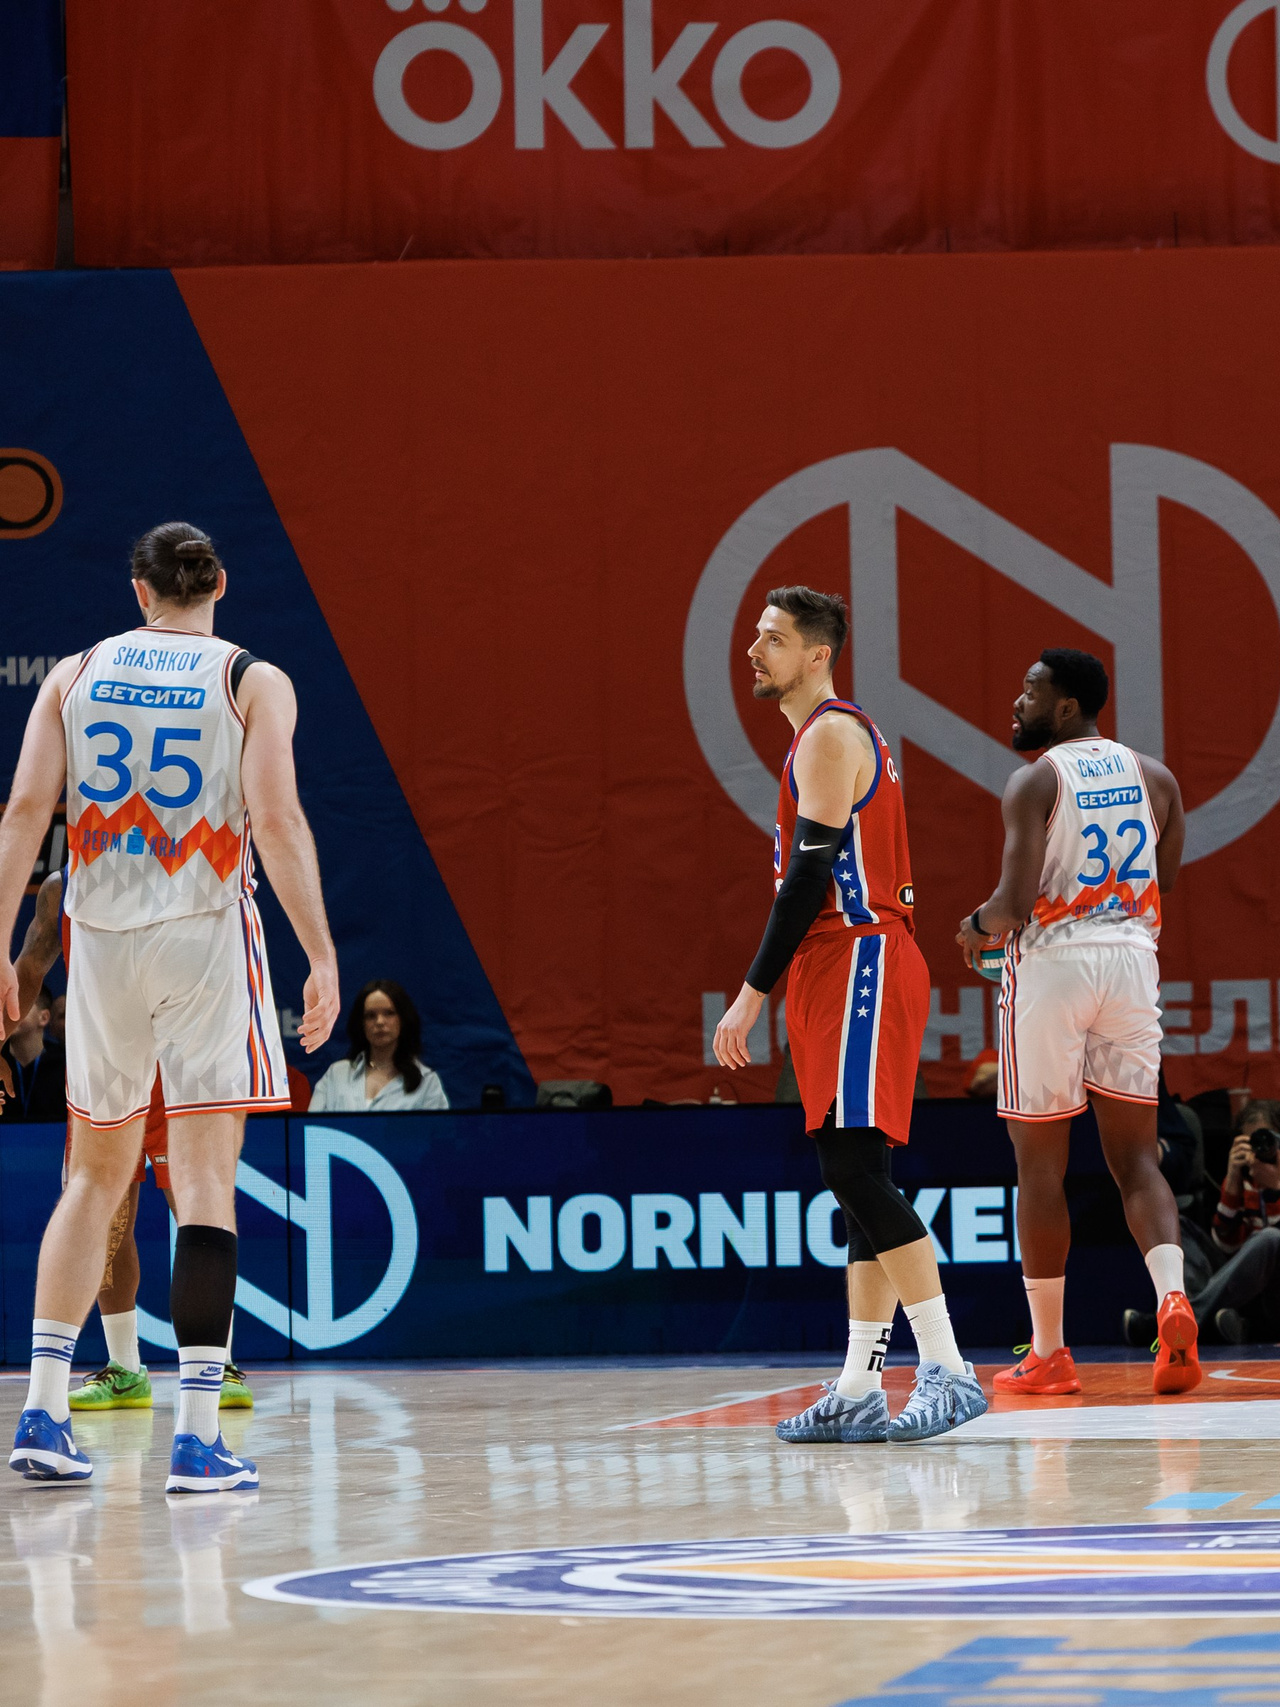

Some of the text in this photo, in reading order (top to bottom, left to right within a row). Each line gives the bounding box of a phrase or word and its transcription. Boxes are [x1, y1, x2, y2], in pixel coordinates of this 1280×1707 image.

[113, 646, 202, 672] SHASHKOV
[95, 684, 201, 706] БЕТСИТИ
[78, 721, 203, 809] 35
[83, 830, 121, 854] PERM
[1077, 819, 1151, 886] 32
